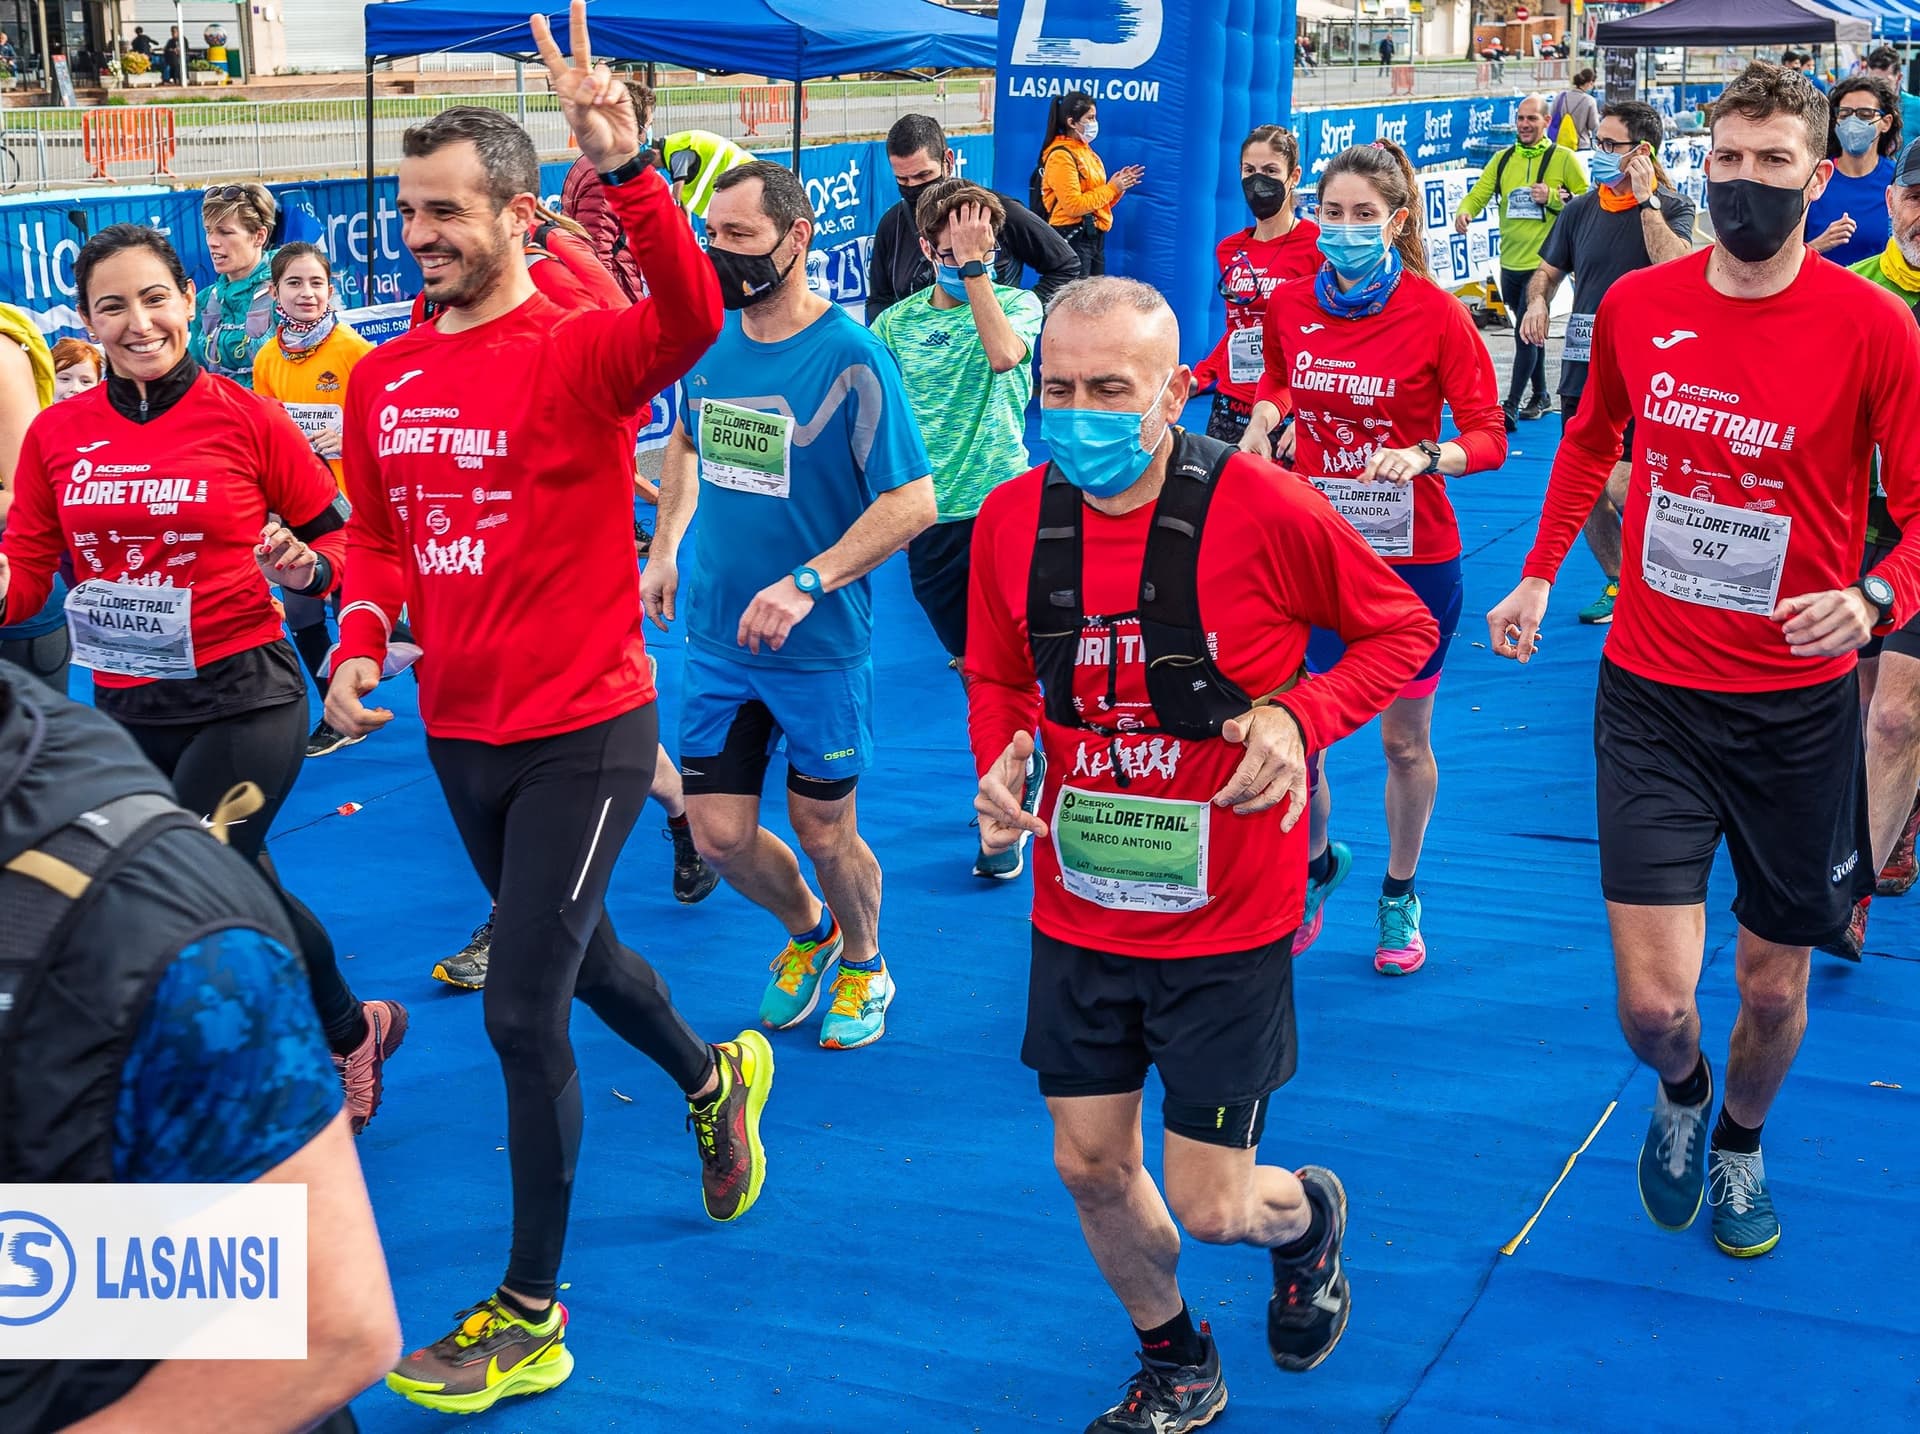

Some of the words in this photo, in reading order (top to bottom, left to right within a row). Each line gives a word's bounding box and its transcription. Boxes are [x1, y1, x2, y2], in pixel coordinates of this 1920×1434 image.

[1008, 76, 1160, 102] LASANSI.COM
[1314, 358, 1356, 369] ACERKO
[1292, 369, 1386, 397] LLORETRAIL
[1678, 384, 1740, 404] ACERKO
[292, 411, 335, 420] LLORETRAIL
[401, 407, 459, 419] ACERKO
[1643, 394, 1779, 449] LLORETRAIL
[296, 421, 326, 430] SALIS
[723, 415, 780, 437] LLORETRAIL
[378, 427, 496, 458] LLORETRAIL
[712, 427, 769, 453] BRUNO
[94, 464, 151, 474] ACERKO
[63, 479, 193, 506] LLORETRAIL
[1339, 490, 1402, 503] LLORETRAIL
[1336, 505, 1391, 517] LEXANDRA
[1672, 502, 1705, 515] ACERKO
[1686, 513, 1771, 541] LLORETRAIL
[1693, 539, 1729, 560] 947
[100, 595, 175, 614] LLORETRAIL
[88, 609, 164, 634] NAIARA
[1077, 799, 1114, 809] ACERKO
[1095, 809, 1189, 832] LLORETRAIL
[1081, 831, 1119, 845] MARCO
[1122, 835, 1172, 850] ANTONIO
[1115, 868, 1144, 877] ANTONIO
